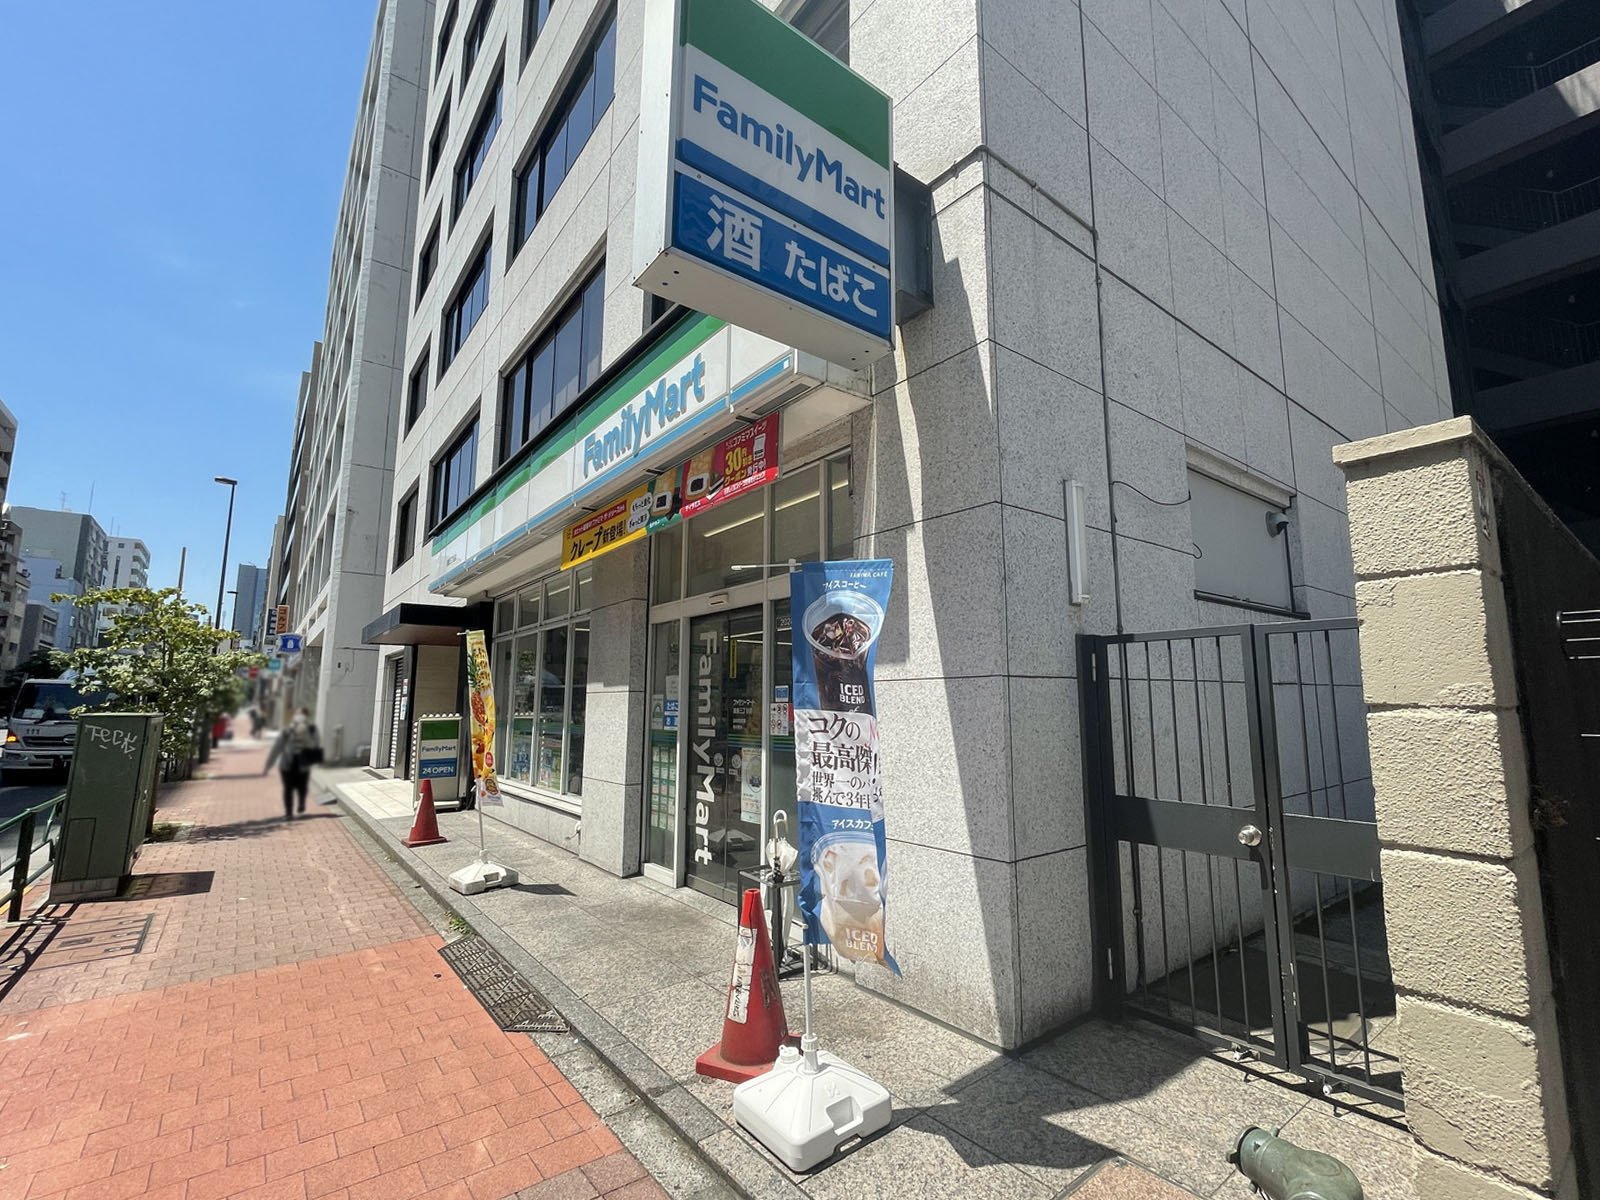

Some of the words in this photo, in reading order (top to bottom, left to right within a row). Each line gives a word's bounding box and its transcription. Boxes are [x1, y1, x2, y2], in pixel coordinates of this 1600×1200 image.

[693, 74, 886, 221] FamilyMart
[706, 194, 763, 272] 酒
[784, 240, 877, 318] たばこ
[583, 351, 706, 479] FamilyMart
[839, 683, 864, 695] ICED
[839, 693, 866, 704] BLEND
[808, 713, 861, 741] コクの
[421, 744, 456, 753] FamilyMart
[693, 631, 718, 866] FamilyMart
[432, 765, 454, 775] OPEN
[846, 927, 878, 945] ICED
